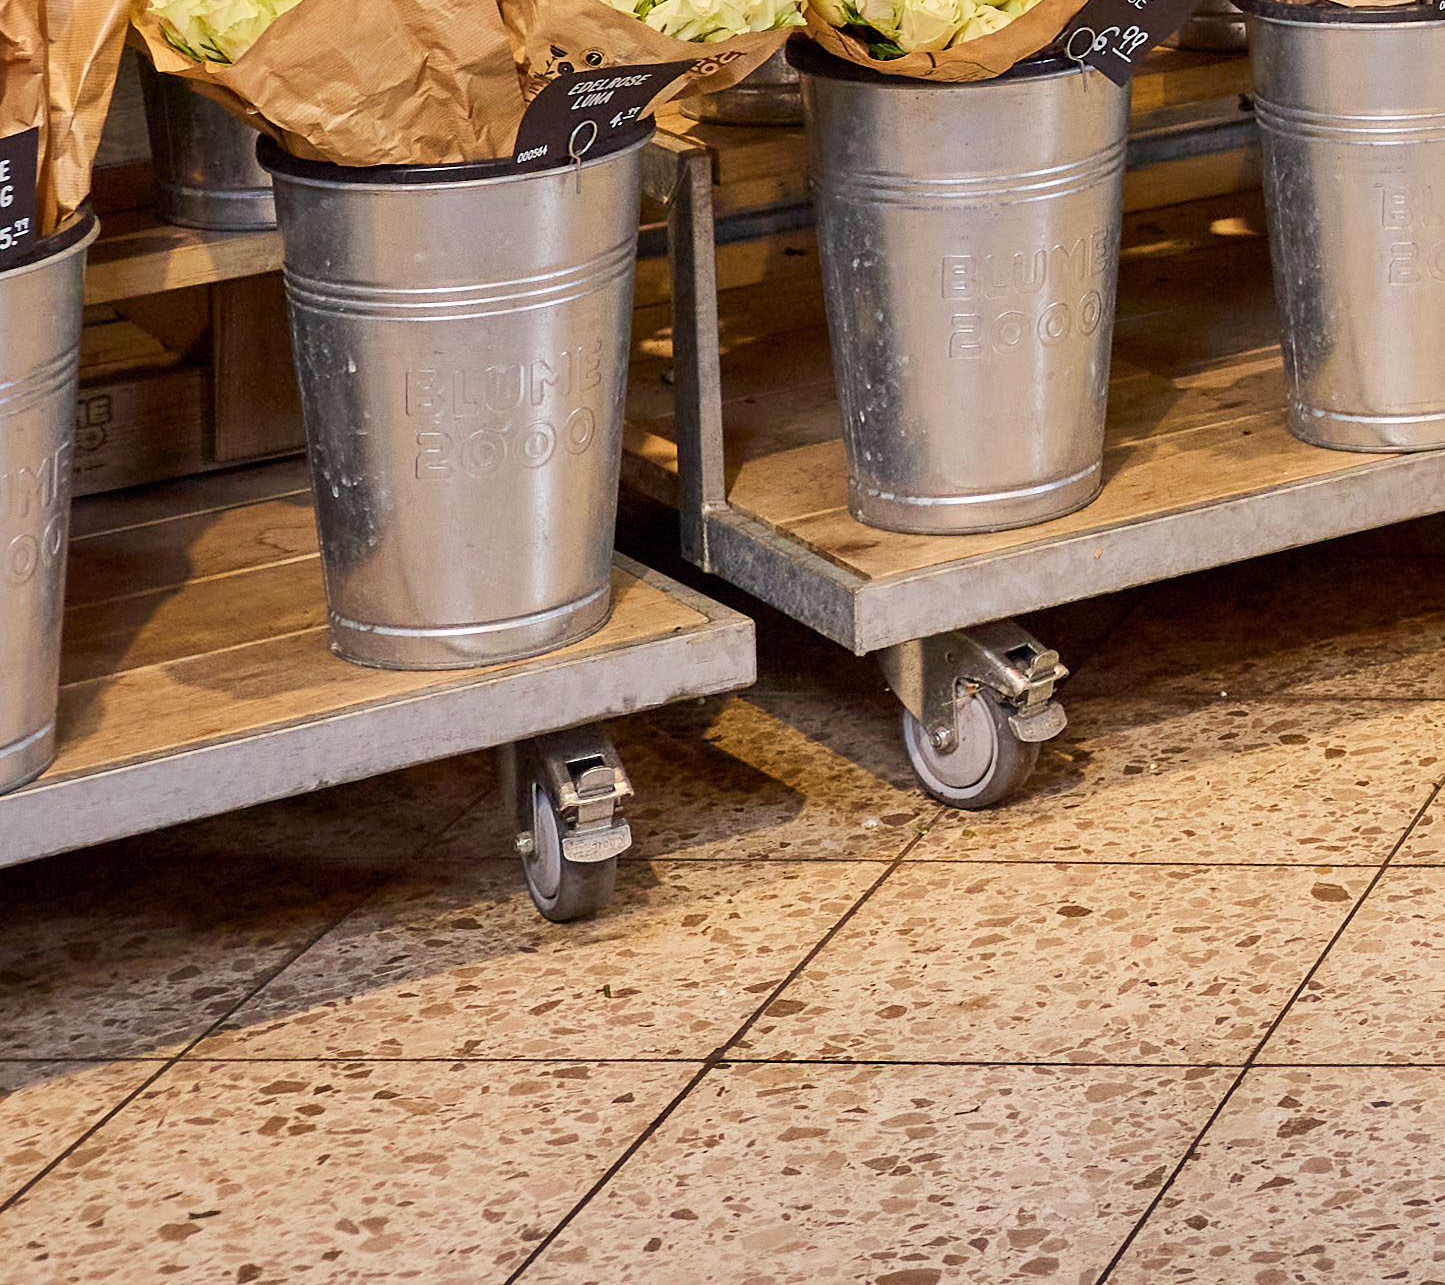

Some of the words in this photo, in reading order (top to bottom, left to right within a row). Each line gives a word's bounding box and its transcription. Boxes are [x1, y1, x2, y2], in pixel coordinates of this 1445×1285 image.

[1093, 25, 1149, 63] 6.99
[568, 73, 653, 96] EDELROSE
[571, 90, 614, 110] LUNA
[948, 290, 1102, 360] 2000
[405, 338, 602, 417] BLUME
[415, 406, 597, 480] 2000
